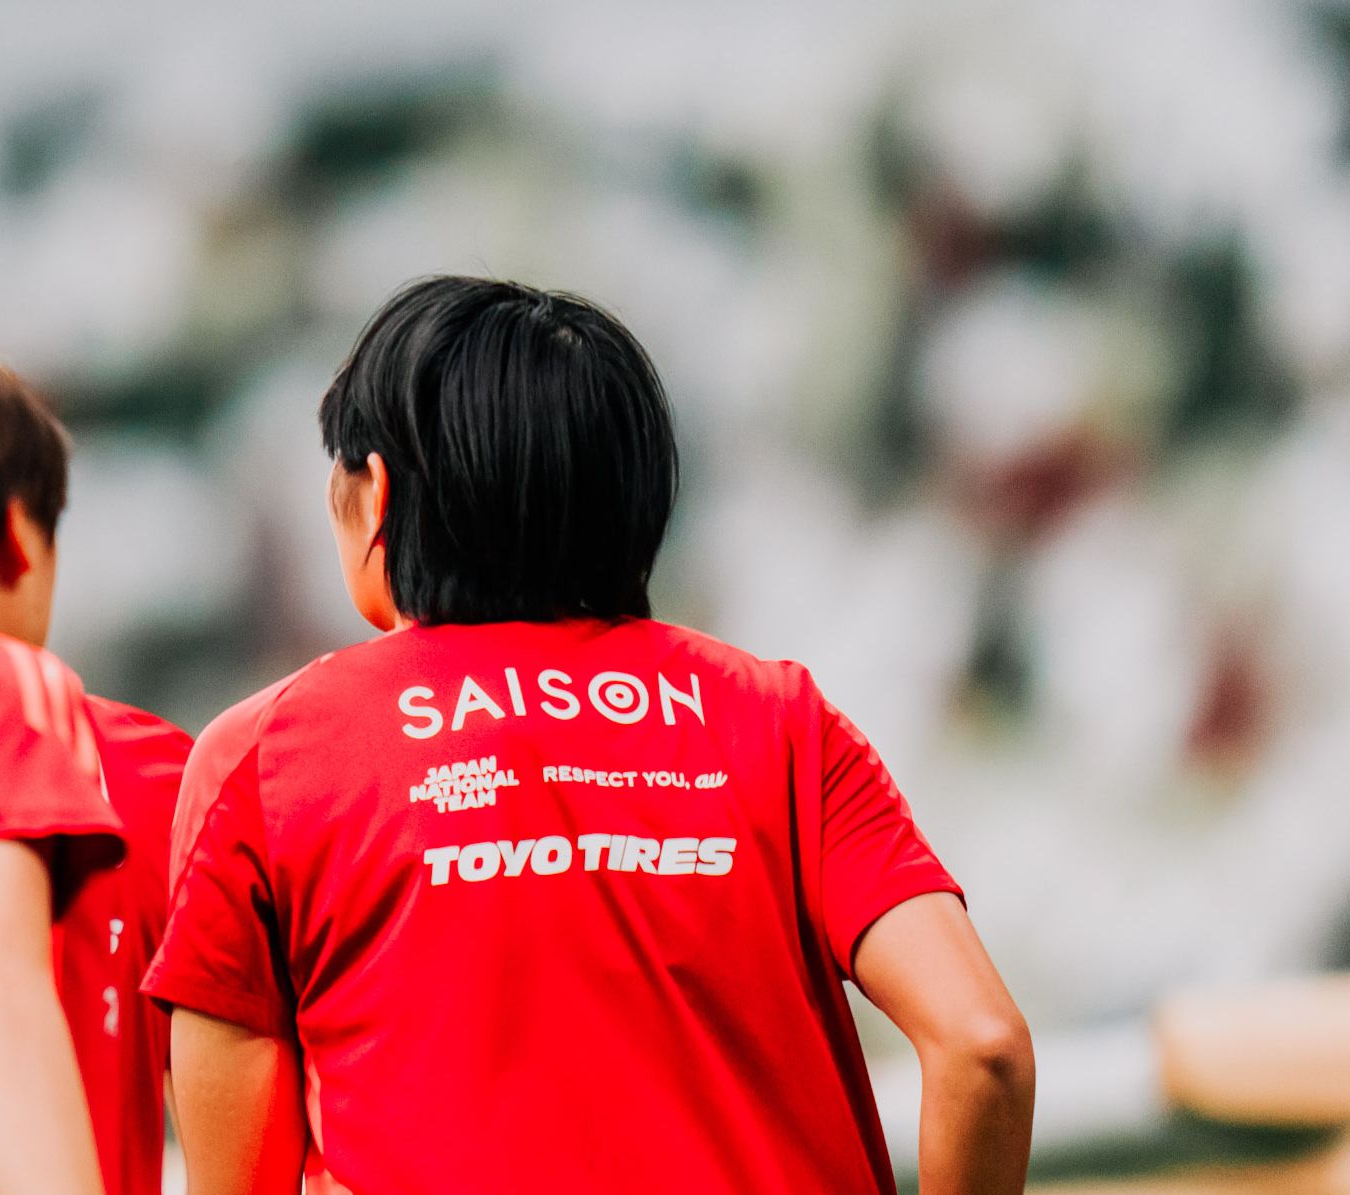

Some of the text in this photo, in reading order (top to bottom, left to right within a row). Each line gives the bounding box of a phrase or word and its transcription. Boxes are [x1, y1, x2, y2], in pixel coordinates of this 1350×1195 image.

[397, 667, 706, 740] SAISON
[409, 769, 521, 803] NATIONAL
[426, 755, 498, 786] JAPAN
[542, 765, 638, 788] RESPECT
[641, 770, 691, 790] YOU,
[433, 789, 497, 813] TEAM
[423, 833, 737, 886] TOYO TIRES
